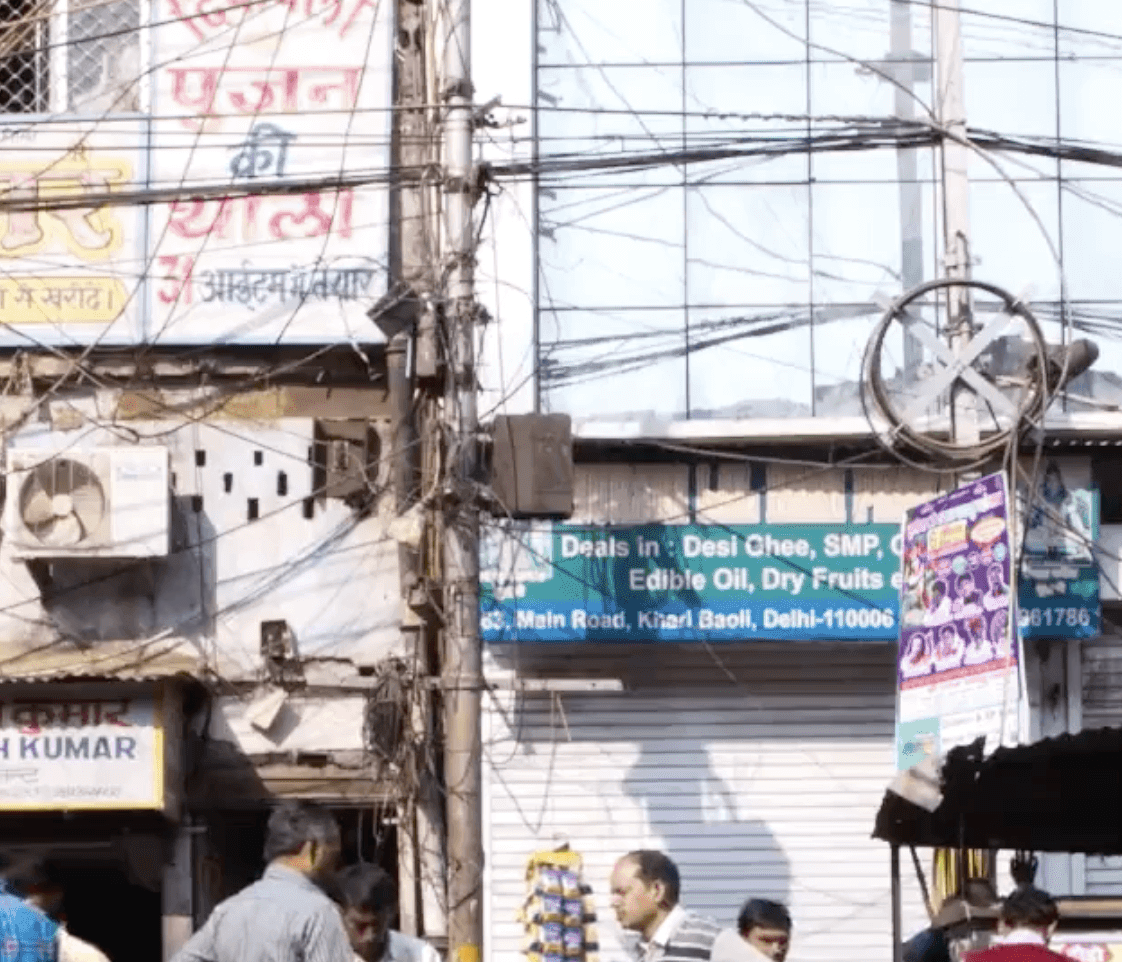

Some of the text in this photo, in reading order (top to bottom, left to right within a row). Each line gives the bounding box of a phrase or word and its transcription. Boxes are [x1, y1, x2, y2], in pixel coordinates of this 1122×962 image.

[228, 122, 297, 178] की
[561, 535, 629, 558] Deals
[636, 535, 660, 557] in
[683, 535, 738, 558] Desi
[824, 533, 885, 561] SMP,
[629, 568, 707, 591] Edible
[713, 567, 756, 595] Oil,
[762, 567, 804, 595] Dry
[812, 566, 884, 590] Fruits
[516, 609, 566, 630] Main
[571, 608, 631, 631] Road,
[638, 608, 693, 630] Khari
[698, 607, 757, 632] Baoli,
[763, 607, 895, 630] Delhi-110006
[20, 736, 137, 761] KUMAR
